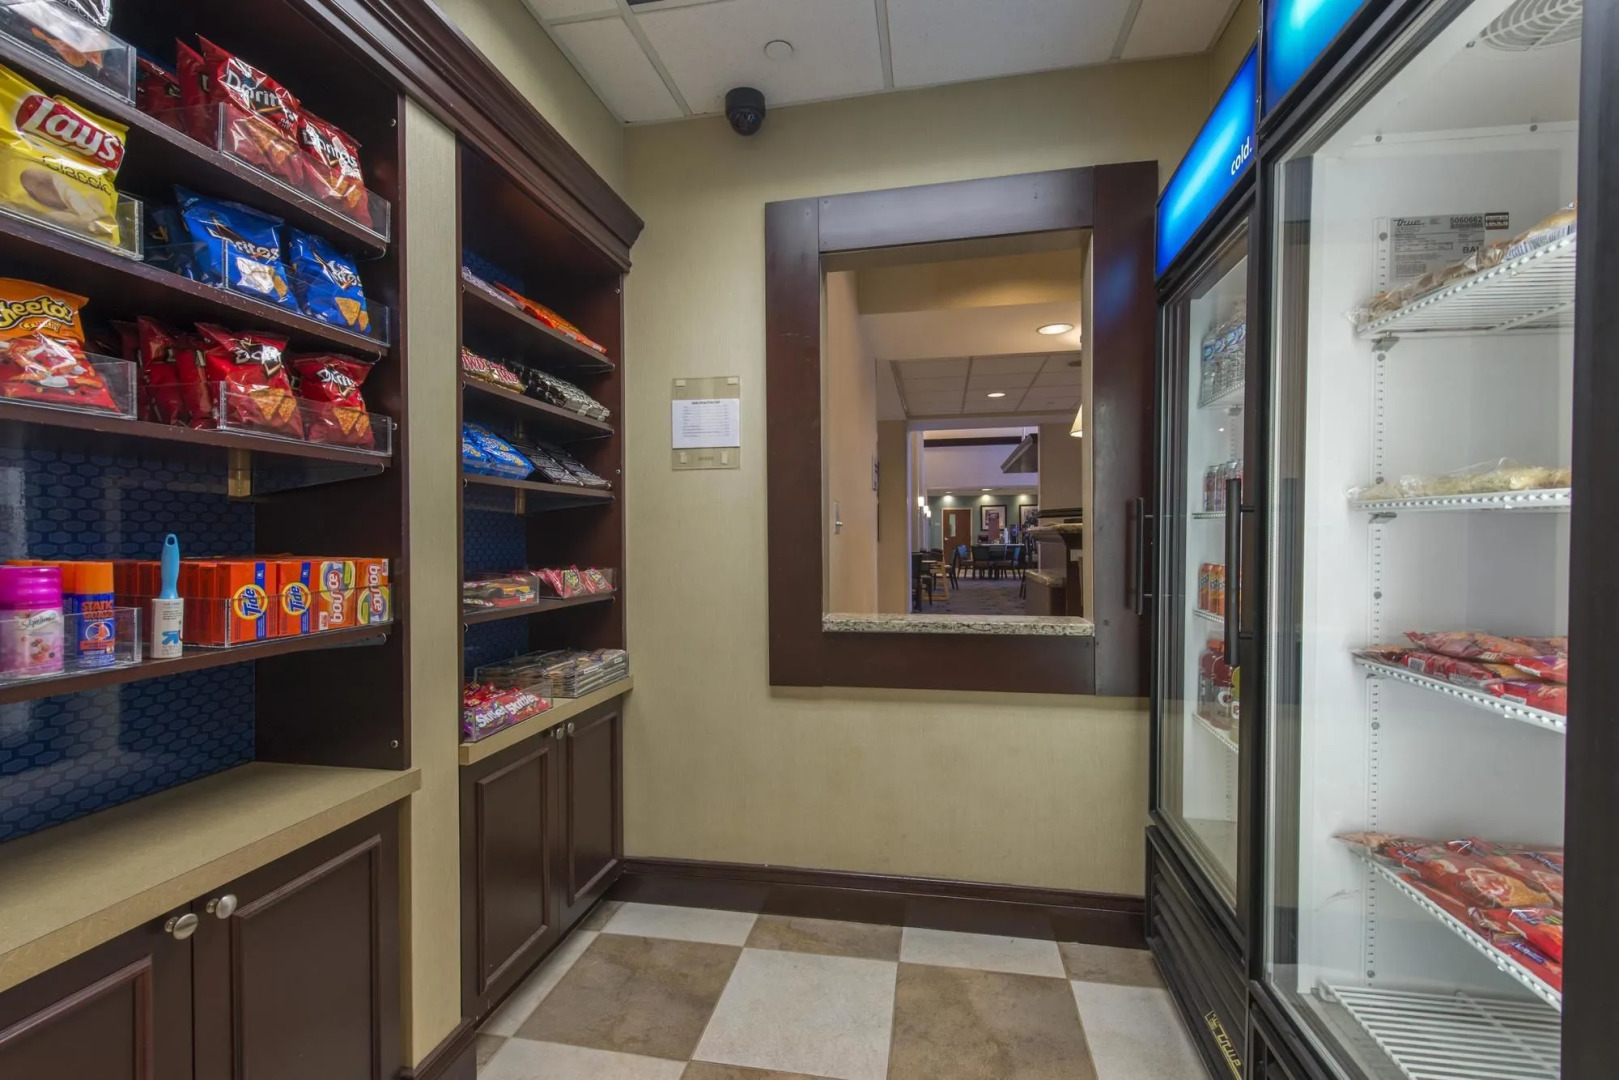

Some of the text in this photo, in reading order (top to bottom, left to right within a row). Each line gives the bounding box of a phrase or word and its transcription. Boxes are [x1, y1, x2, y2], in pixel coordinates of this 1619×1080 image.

[1230, 136, 1252, 176] cold.
[242, 587, 263, 617] Tide
[286, 585, 306, 612] Tide
[329, 571, 344, 624] bouce
